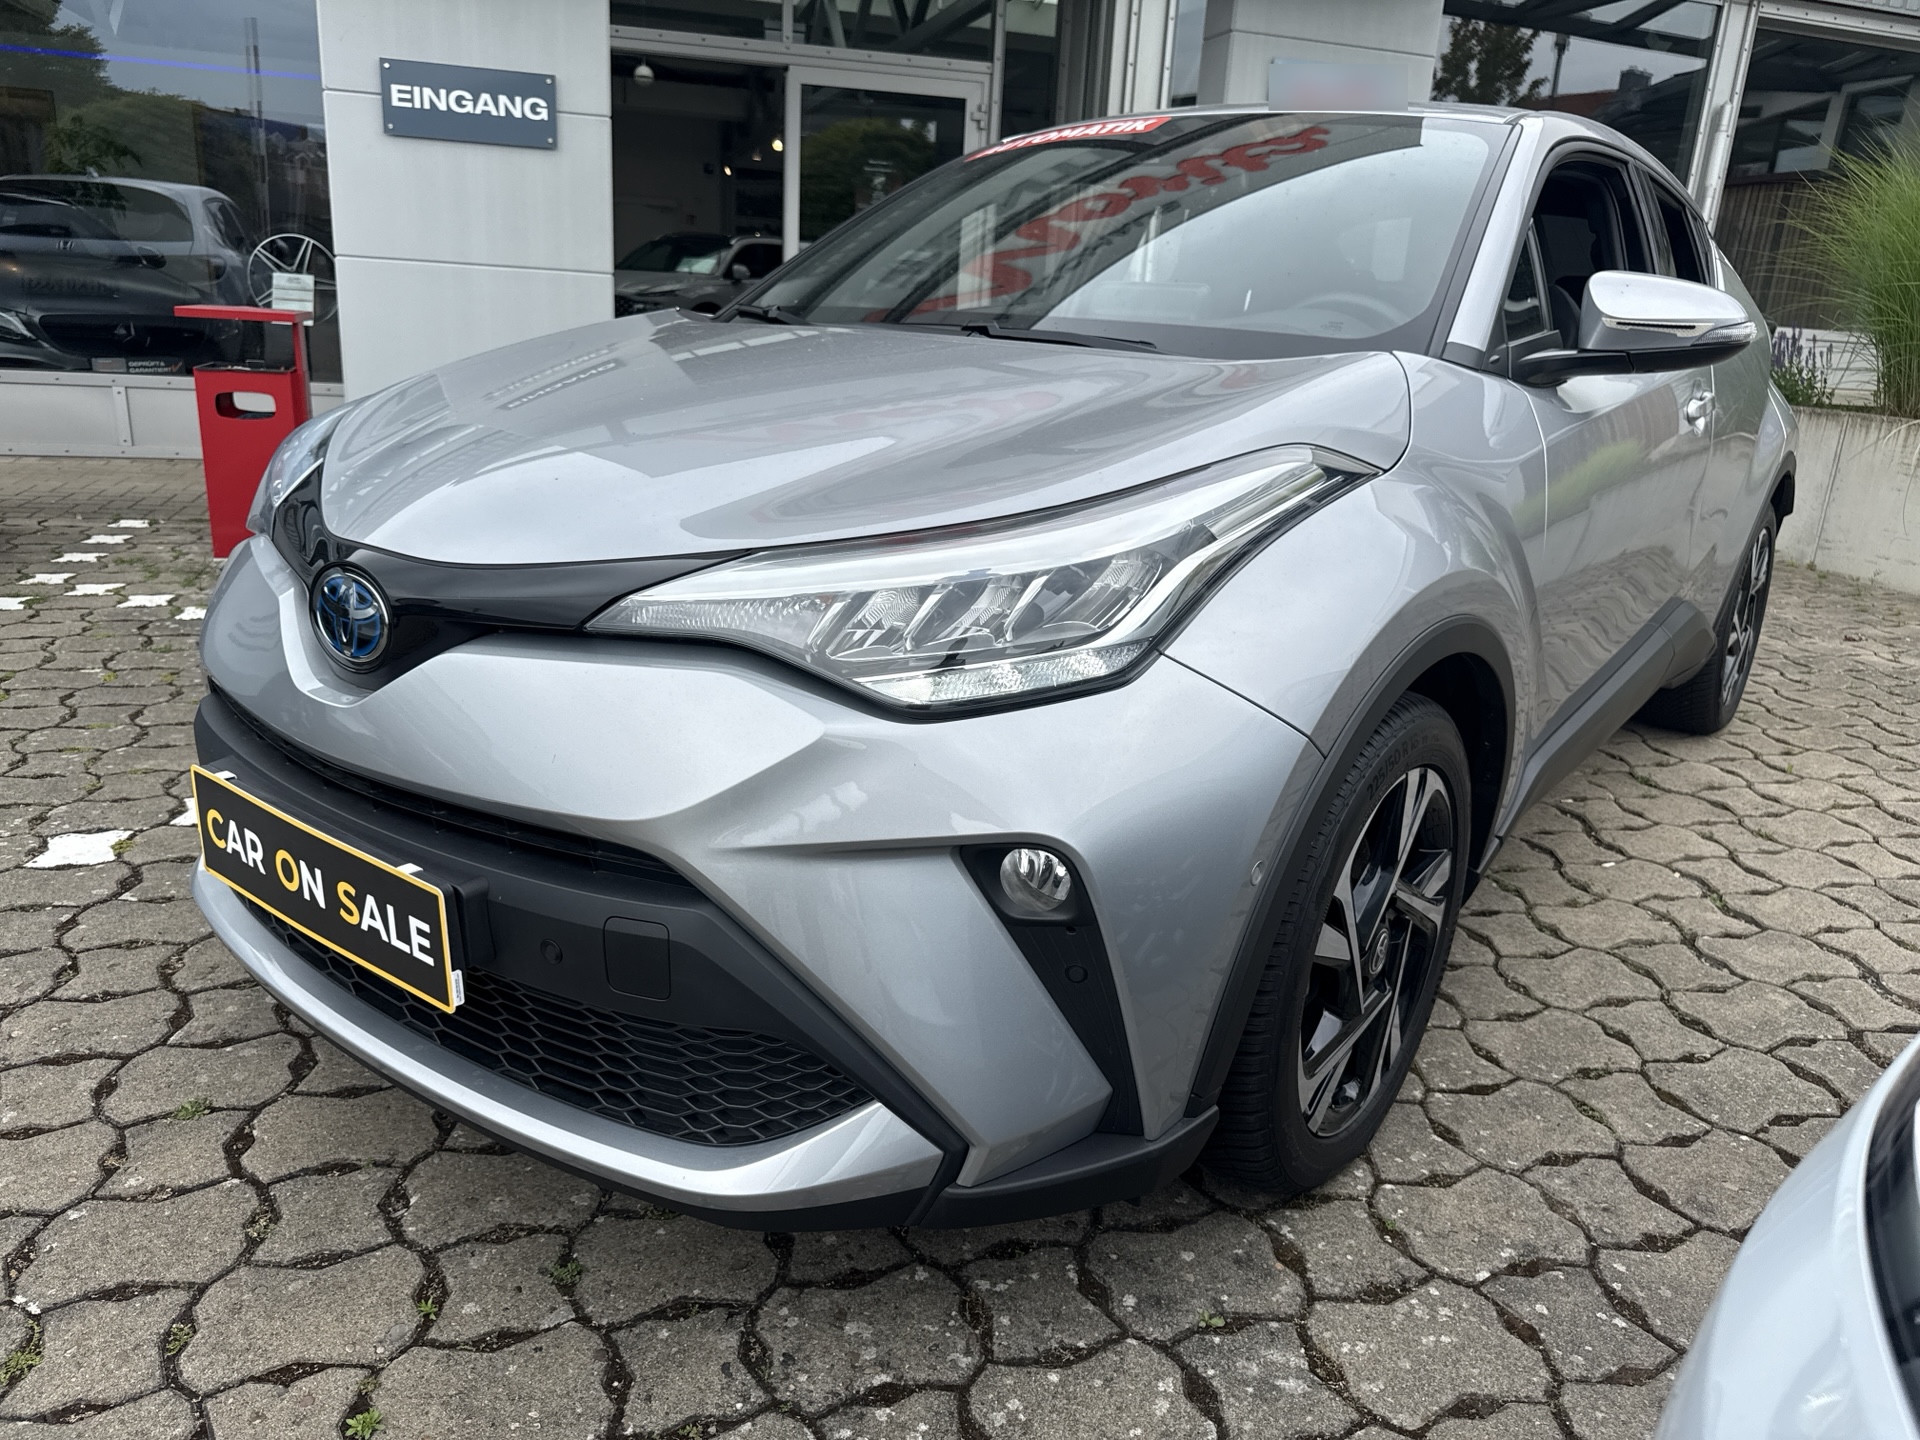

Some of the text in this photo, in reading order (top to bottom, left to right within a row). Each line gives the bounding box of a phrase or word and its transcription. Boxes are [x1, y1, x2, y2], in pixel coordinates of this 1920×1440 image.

[390, 83, 549, 121] EINGANG
[206, 808, 435, 967] CAR ON SALE
